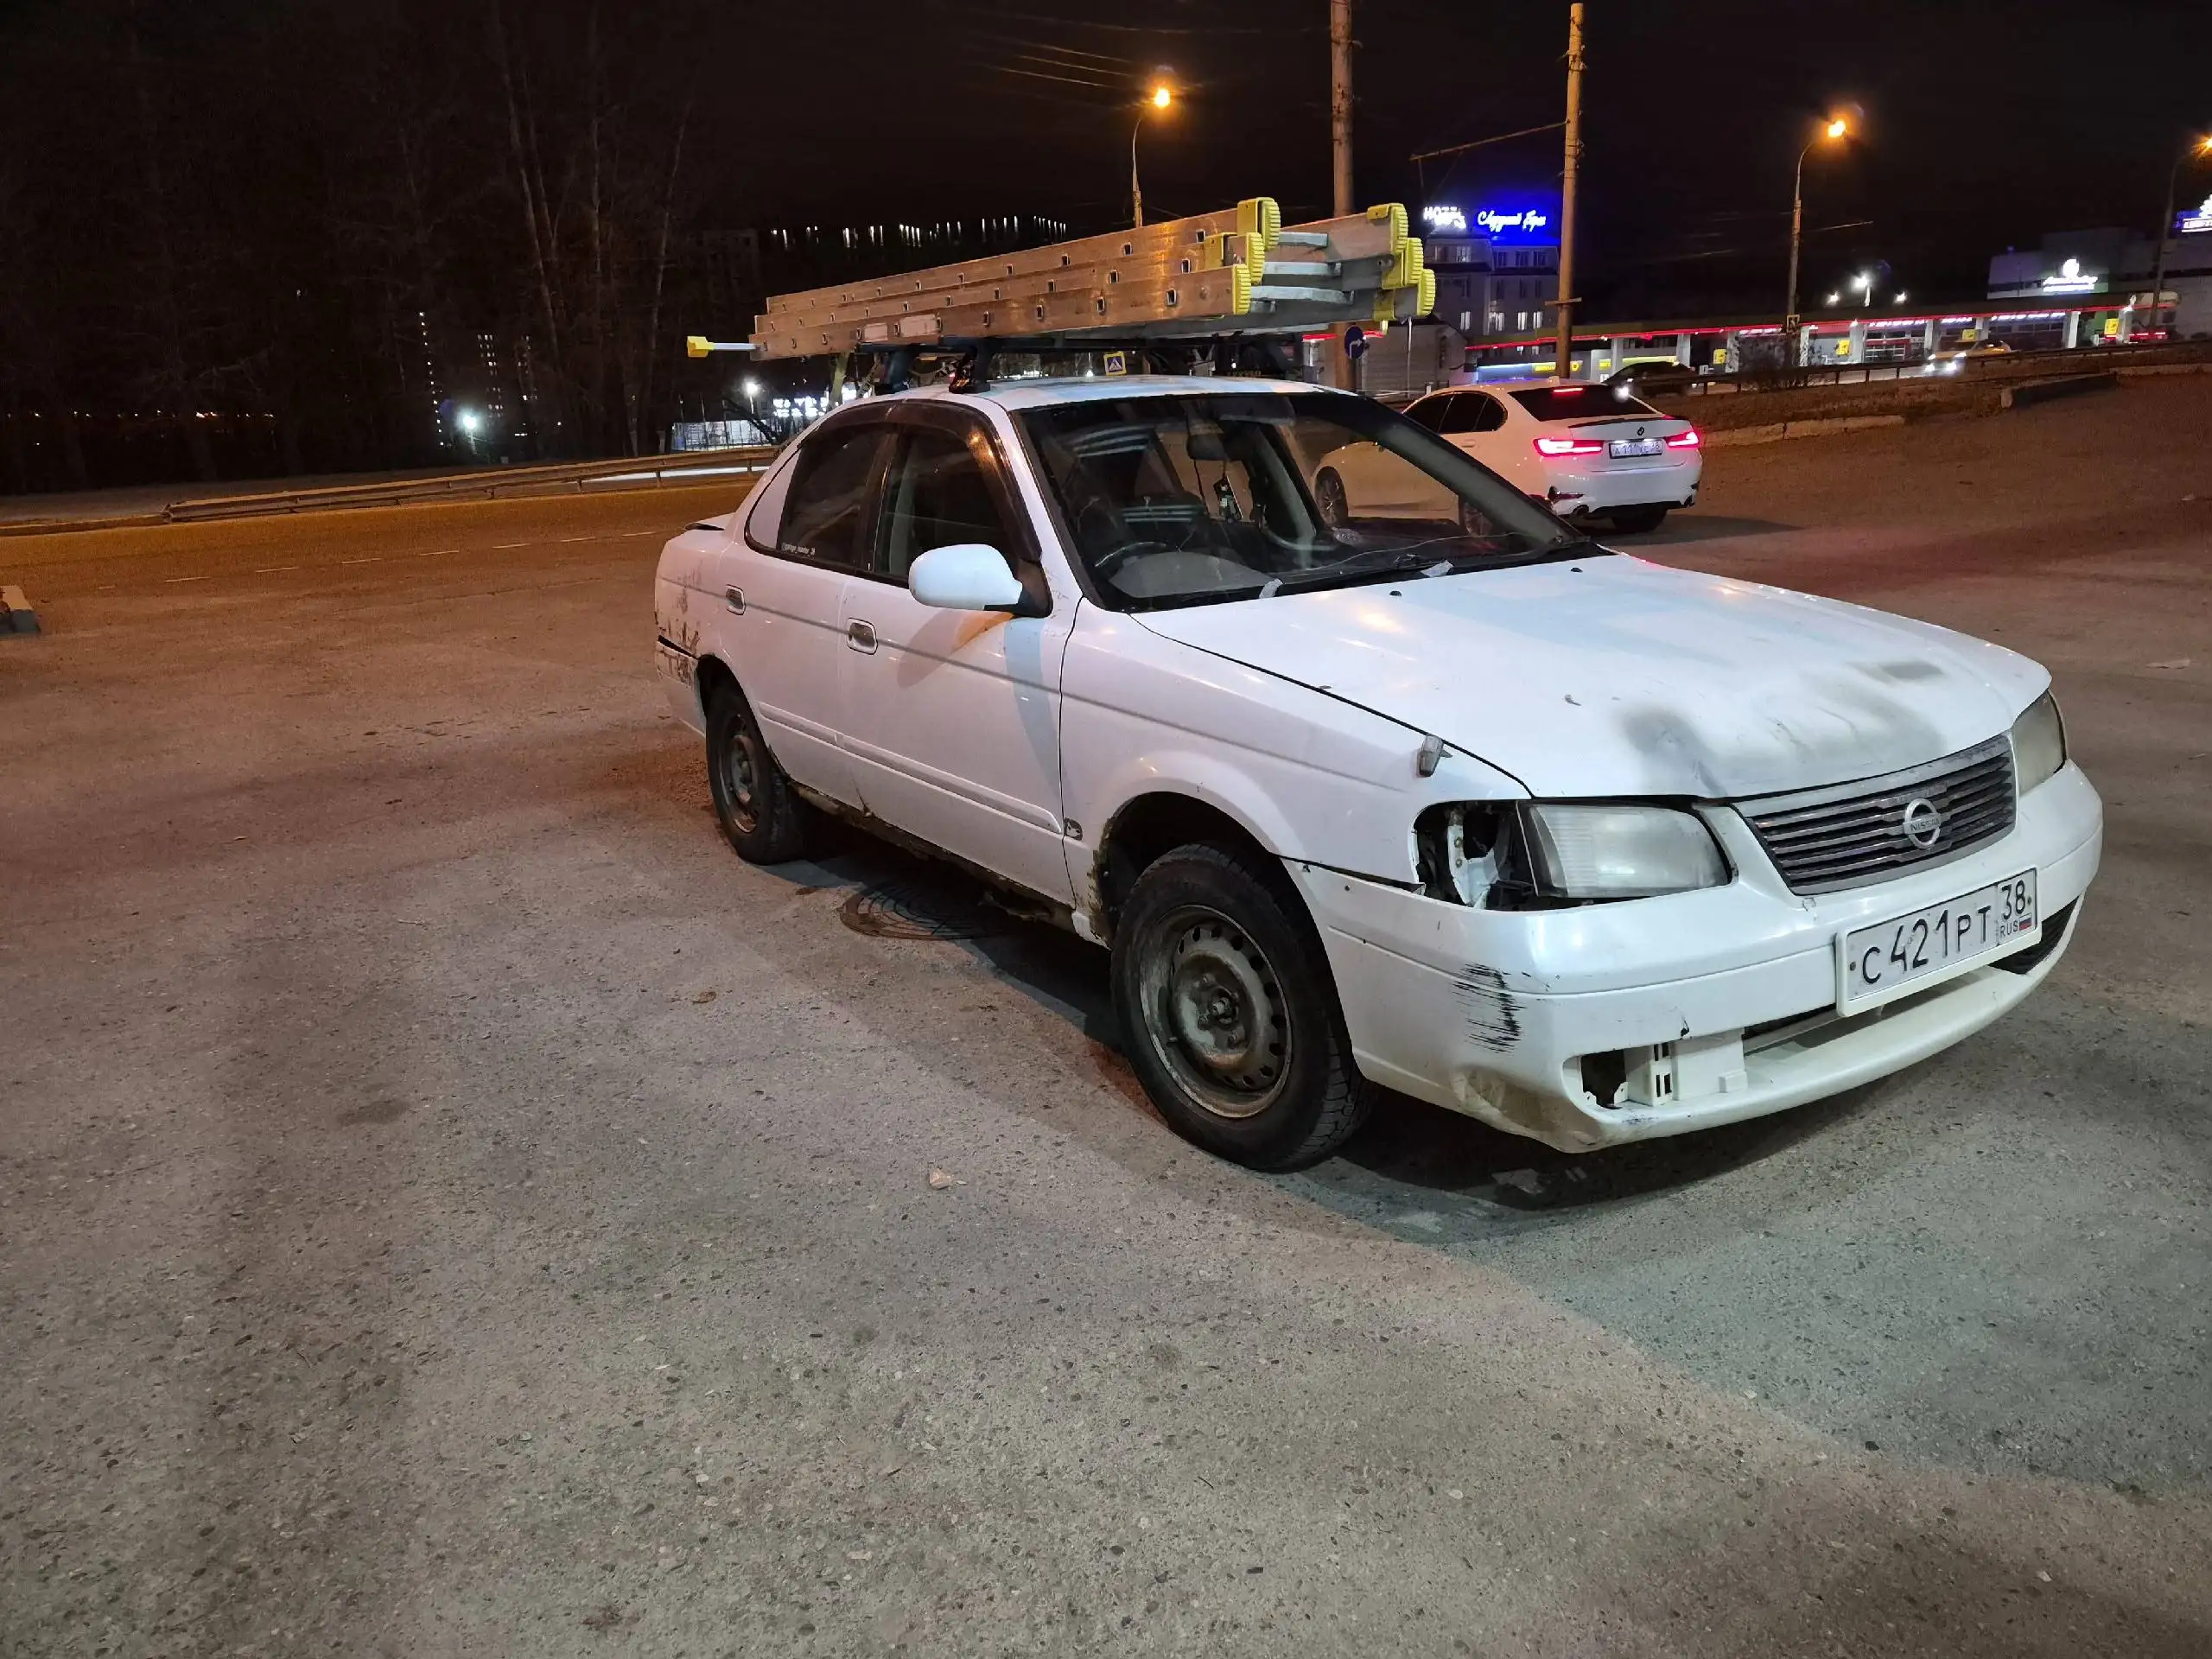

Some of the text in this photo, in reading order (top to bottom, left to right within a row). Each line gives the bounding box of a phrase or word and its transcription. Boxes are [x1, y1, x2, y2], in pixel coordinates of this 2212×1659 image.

[1862, 880, 2026, 984] С421РТ 38
[1999, 919, 2018, 938] RUS
